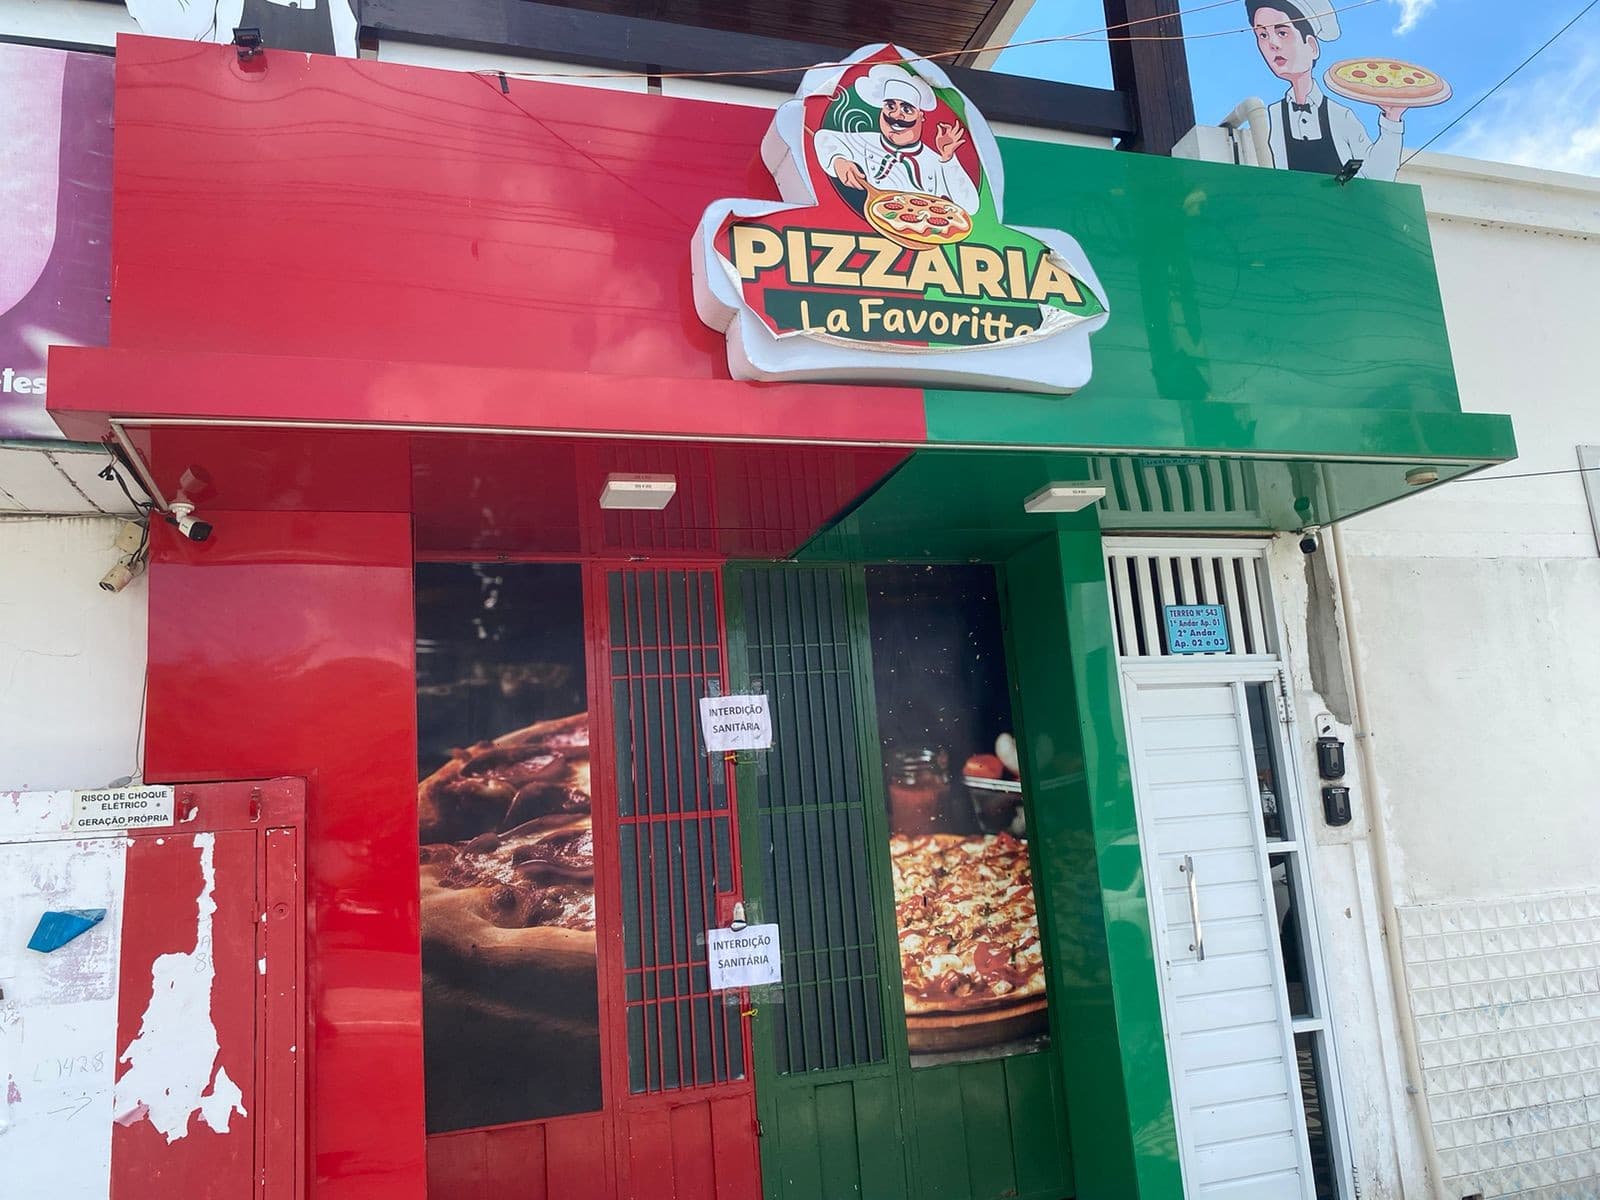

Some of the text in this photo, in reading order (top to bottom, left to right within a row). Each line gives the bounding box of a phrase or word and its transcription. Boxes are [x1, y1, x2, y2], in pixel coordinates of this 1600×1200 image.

[733, 225, 1084, 304] PIZZARIA
[800, 300, 851, 333] La
[0, 367, 47, 394] tes
[1179, 619, 1198, 627] Andar
[1212, 618, 1220, 626] 01
[1190, 628, 1216, 637] Andar
[1174, 639, 1190, 649] Ap.
[1191, 638, 1203, 647] 02
[1213, 638, 1225, 646] 03
[708, 704, 763, 717] INTERDIÇÃO
[712, 721, 761, 734] SANITÁRIA
[81, 791, 168, 803] RISCO DE CHOQUE
[101, 800, 148, 811] ELÉTRICO
[78, 816, 125, 826] GERAÇÃO
[127, 813, 169, 824] PRÓPRIA
[713, 935, 771, 951] INTERDIÇÃO
[718, 954, 769, 969] SANITÁRIA
